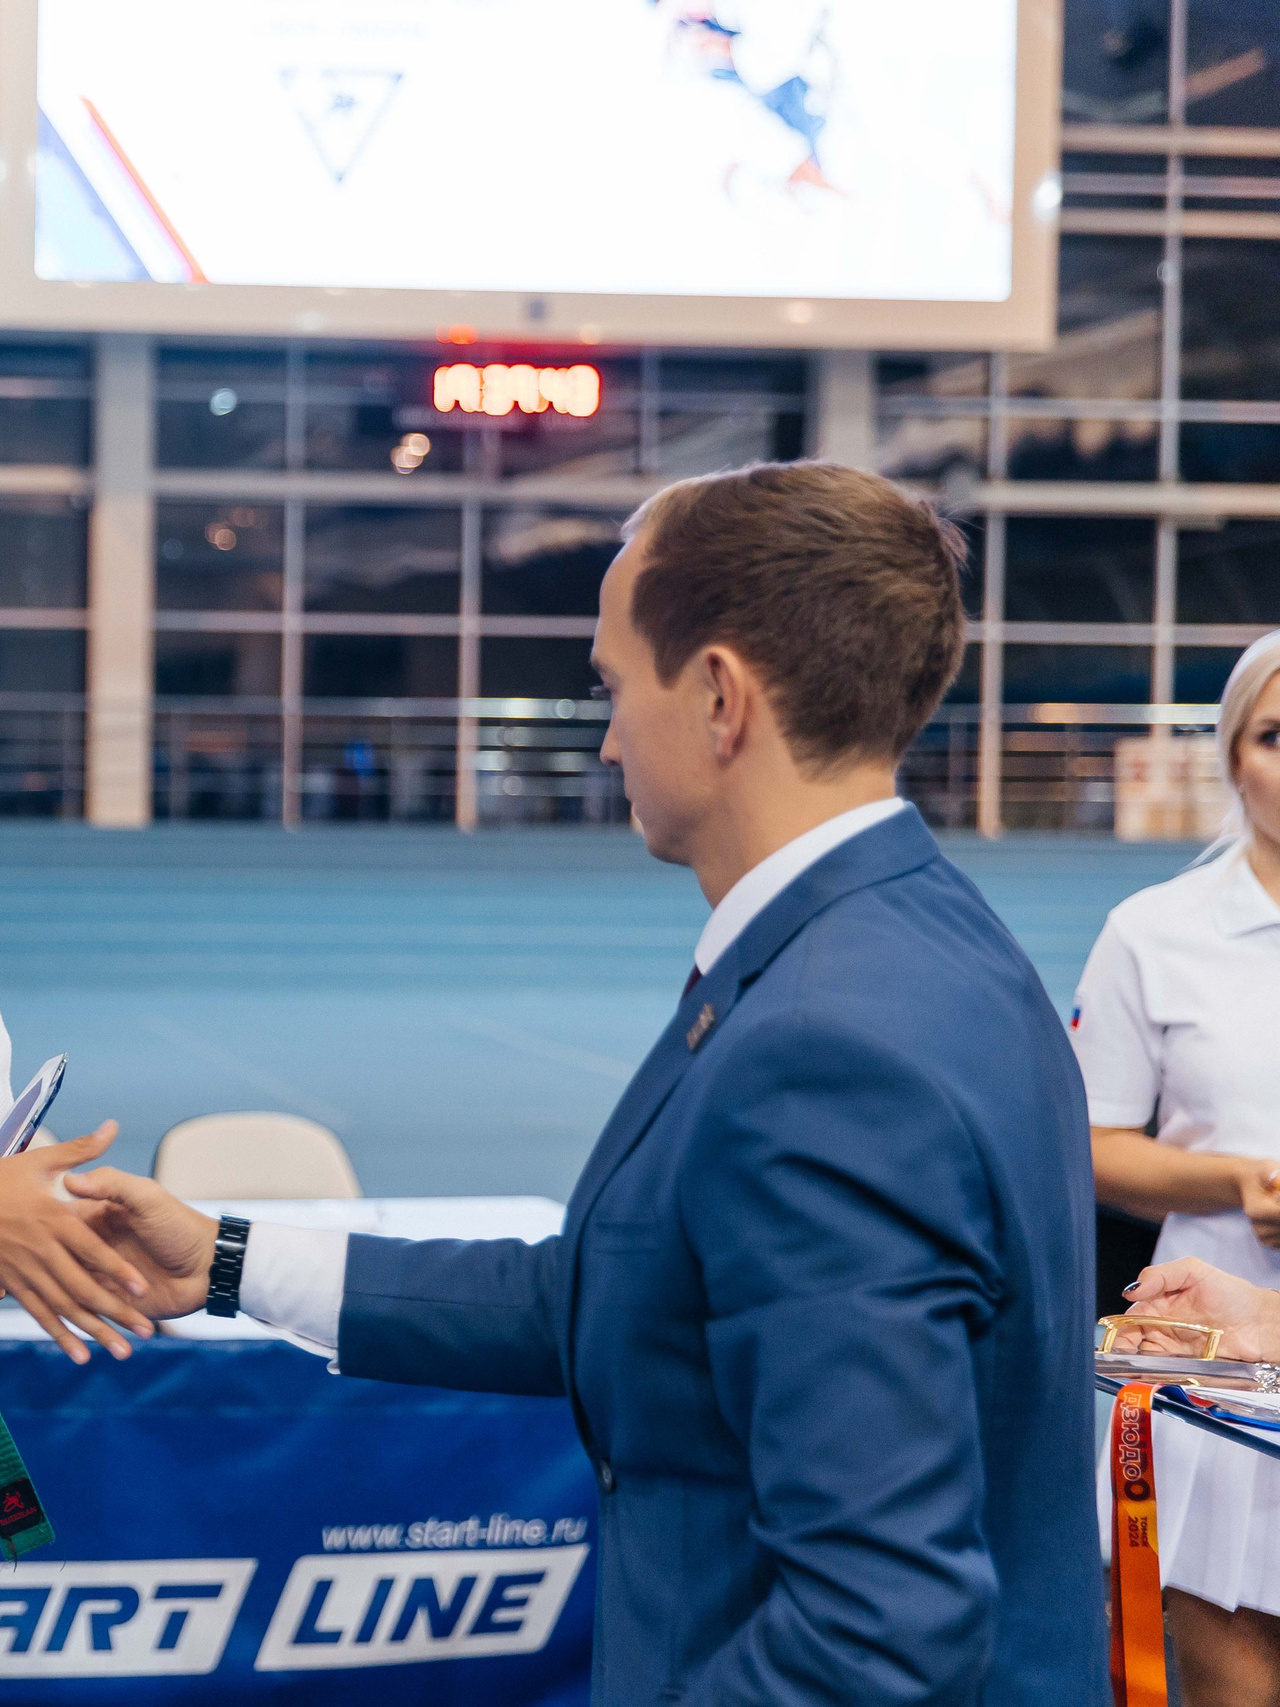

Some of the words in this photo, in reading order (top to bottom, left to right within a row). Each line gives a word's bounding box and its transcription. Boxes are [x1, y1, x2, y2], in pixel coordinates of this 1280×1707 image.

[1119, 1392, 1142, 1481] ДЗЮДО
[322, 1512, 588, 1550] www.start-line.ru
[1128, 1516, 1139, 1548] 2024
[292, 1571, 548, 1644] LINE
